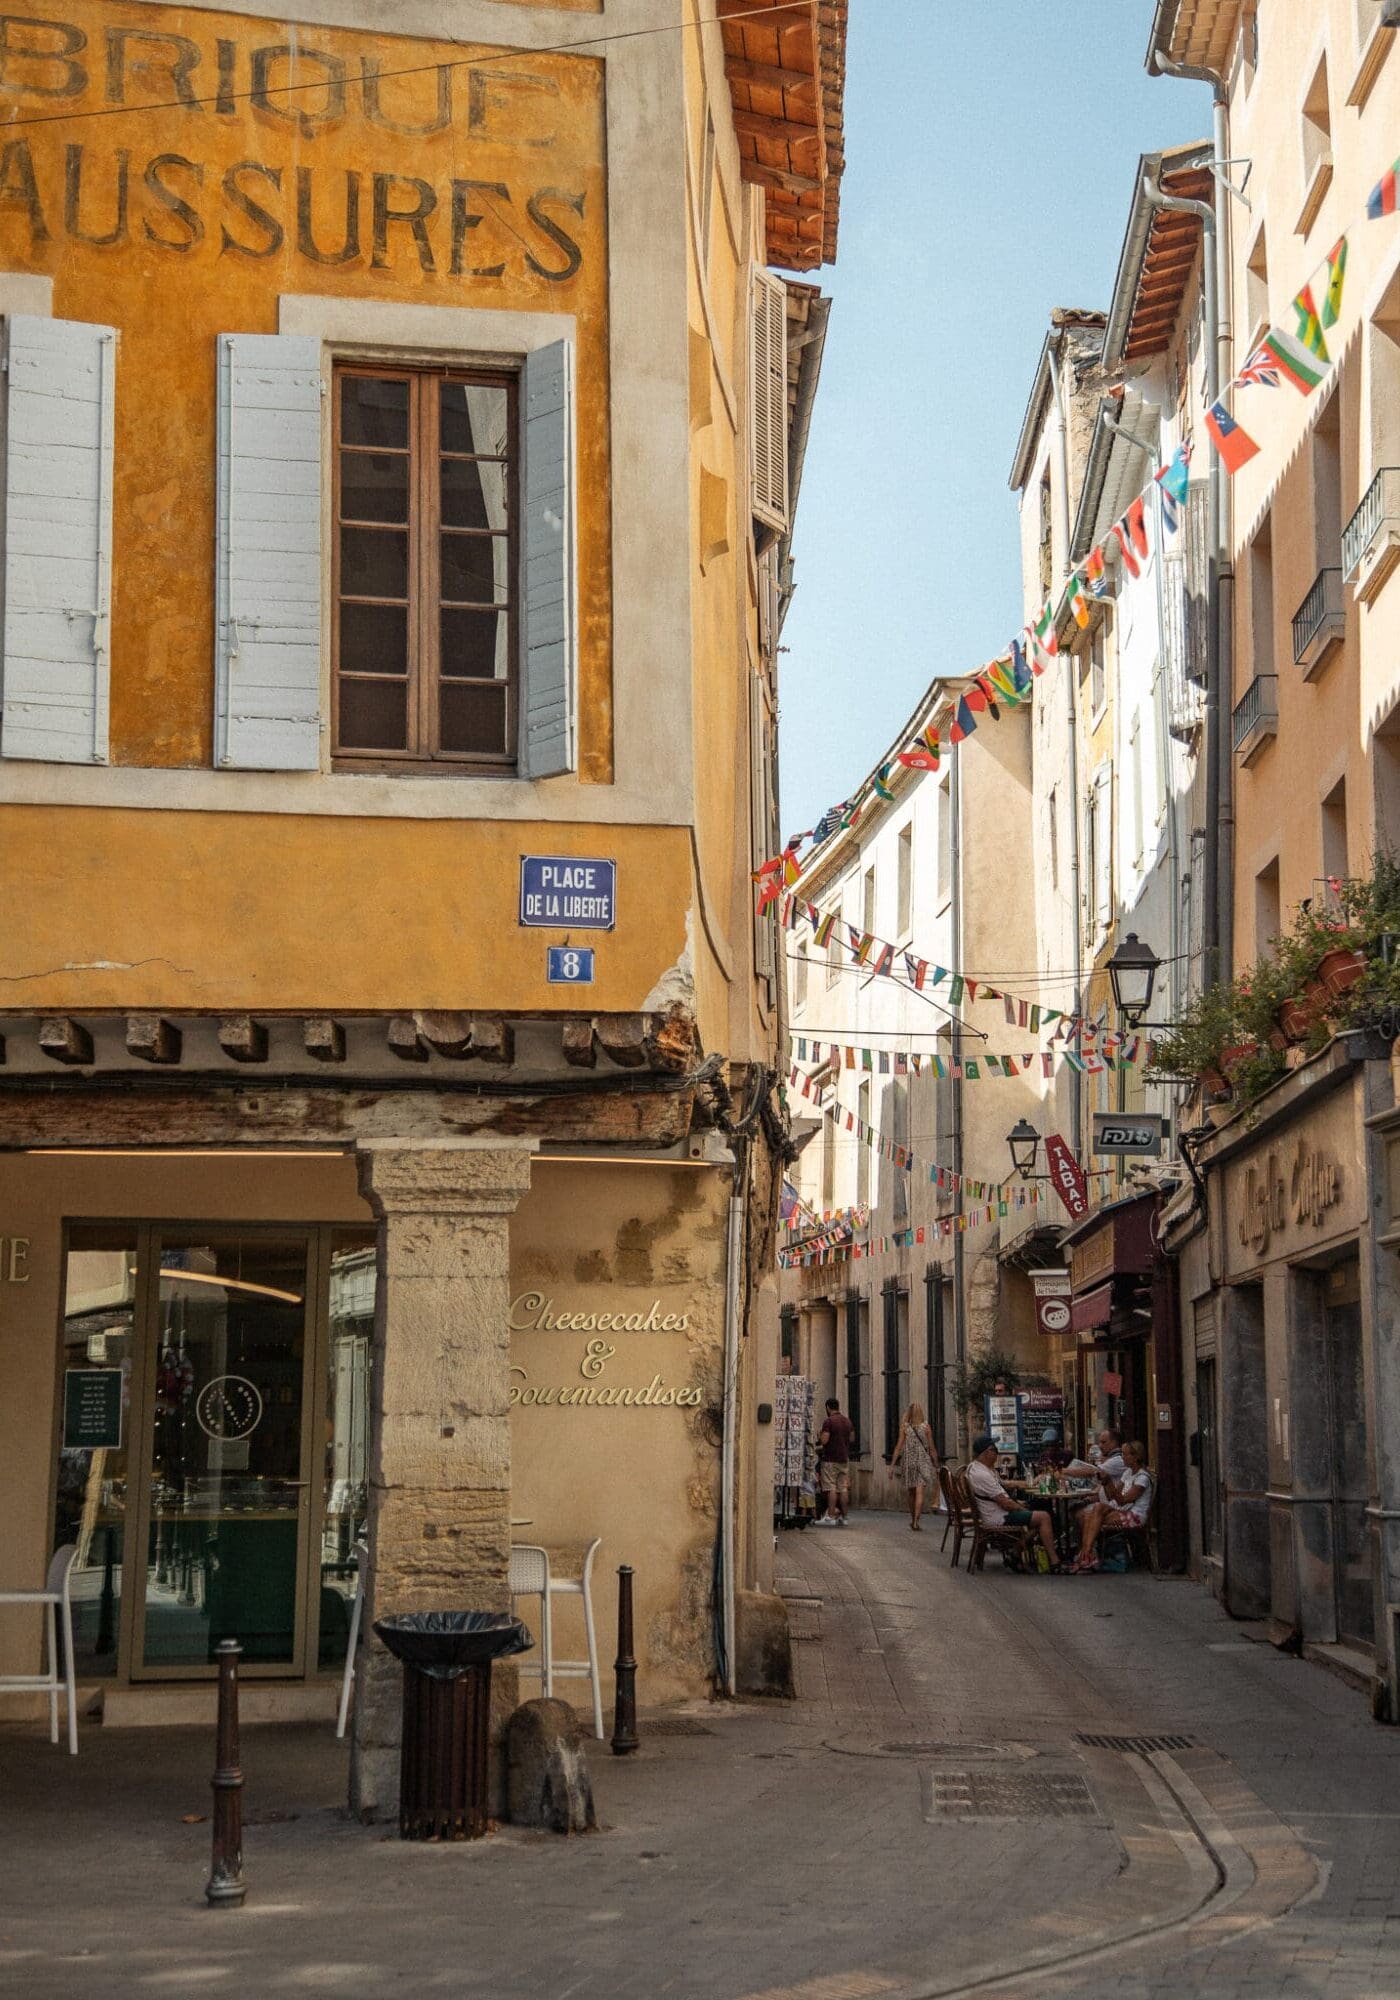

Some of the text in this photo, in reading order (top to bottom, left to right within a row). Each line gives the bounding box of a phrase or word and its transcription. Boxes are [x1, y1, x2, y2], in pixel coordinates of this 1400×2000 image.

[0, 137, 588, 282] AUSSURES
[541, 865, 597, 890] PLACE
[526, 894, 610, 919] DE LA LIBERTÉ
[562, 952, 580, 979] 8
[1103, 1129, 1135, 1144] FDJ
[1052, 1146, 1084, 1212] TABAC
[509, 1290, 689, 1332] Cheesecakes
[581, 1338, 616, 1379] &
